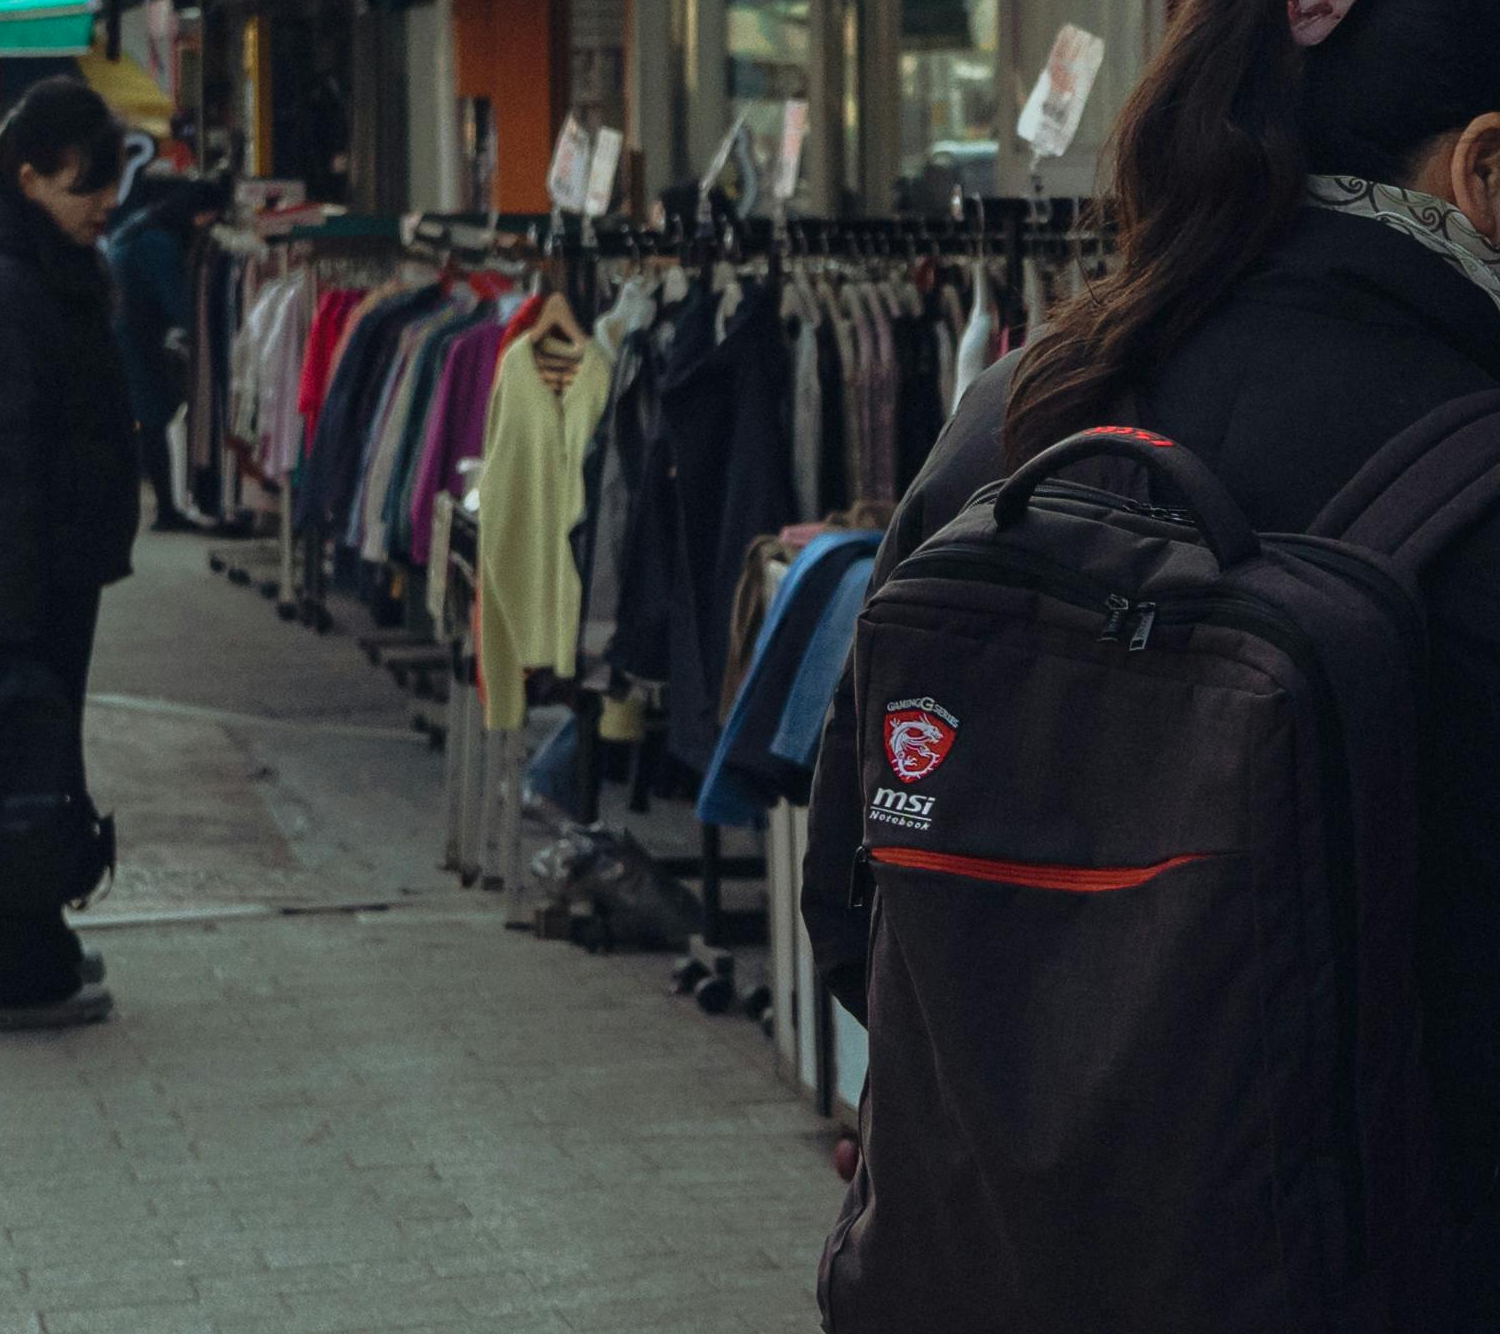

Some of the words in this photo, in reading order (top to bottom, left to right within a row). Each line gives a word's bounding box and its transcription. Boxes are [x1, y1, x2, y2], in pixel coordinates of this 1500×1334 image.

[887, 698, 921, 712] GAMING
[920, 696, 935, 711] G
[933, 704, 958, 728] SERIES
[873, 788, 935, 815] msi
[869, 811, 931, 830] Notebook
